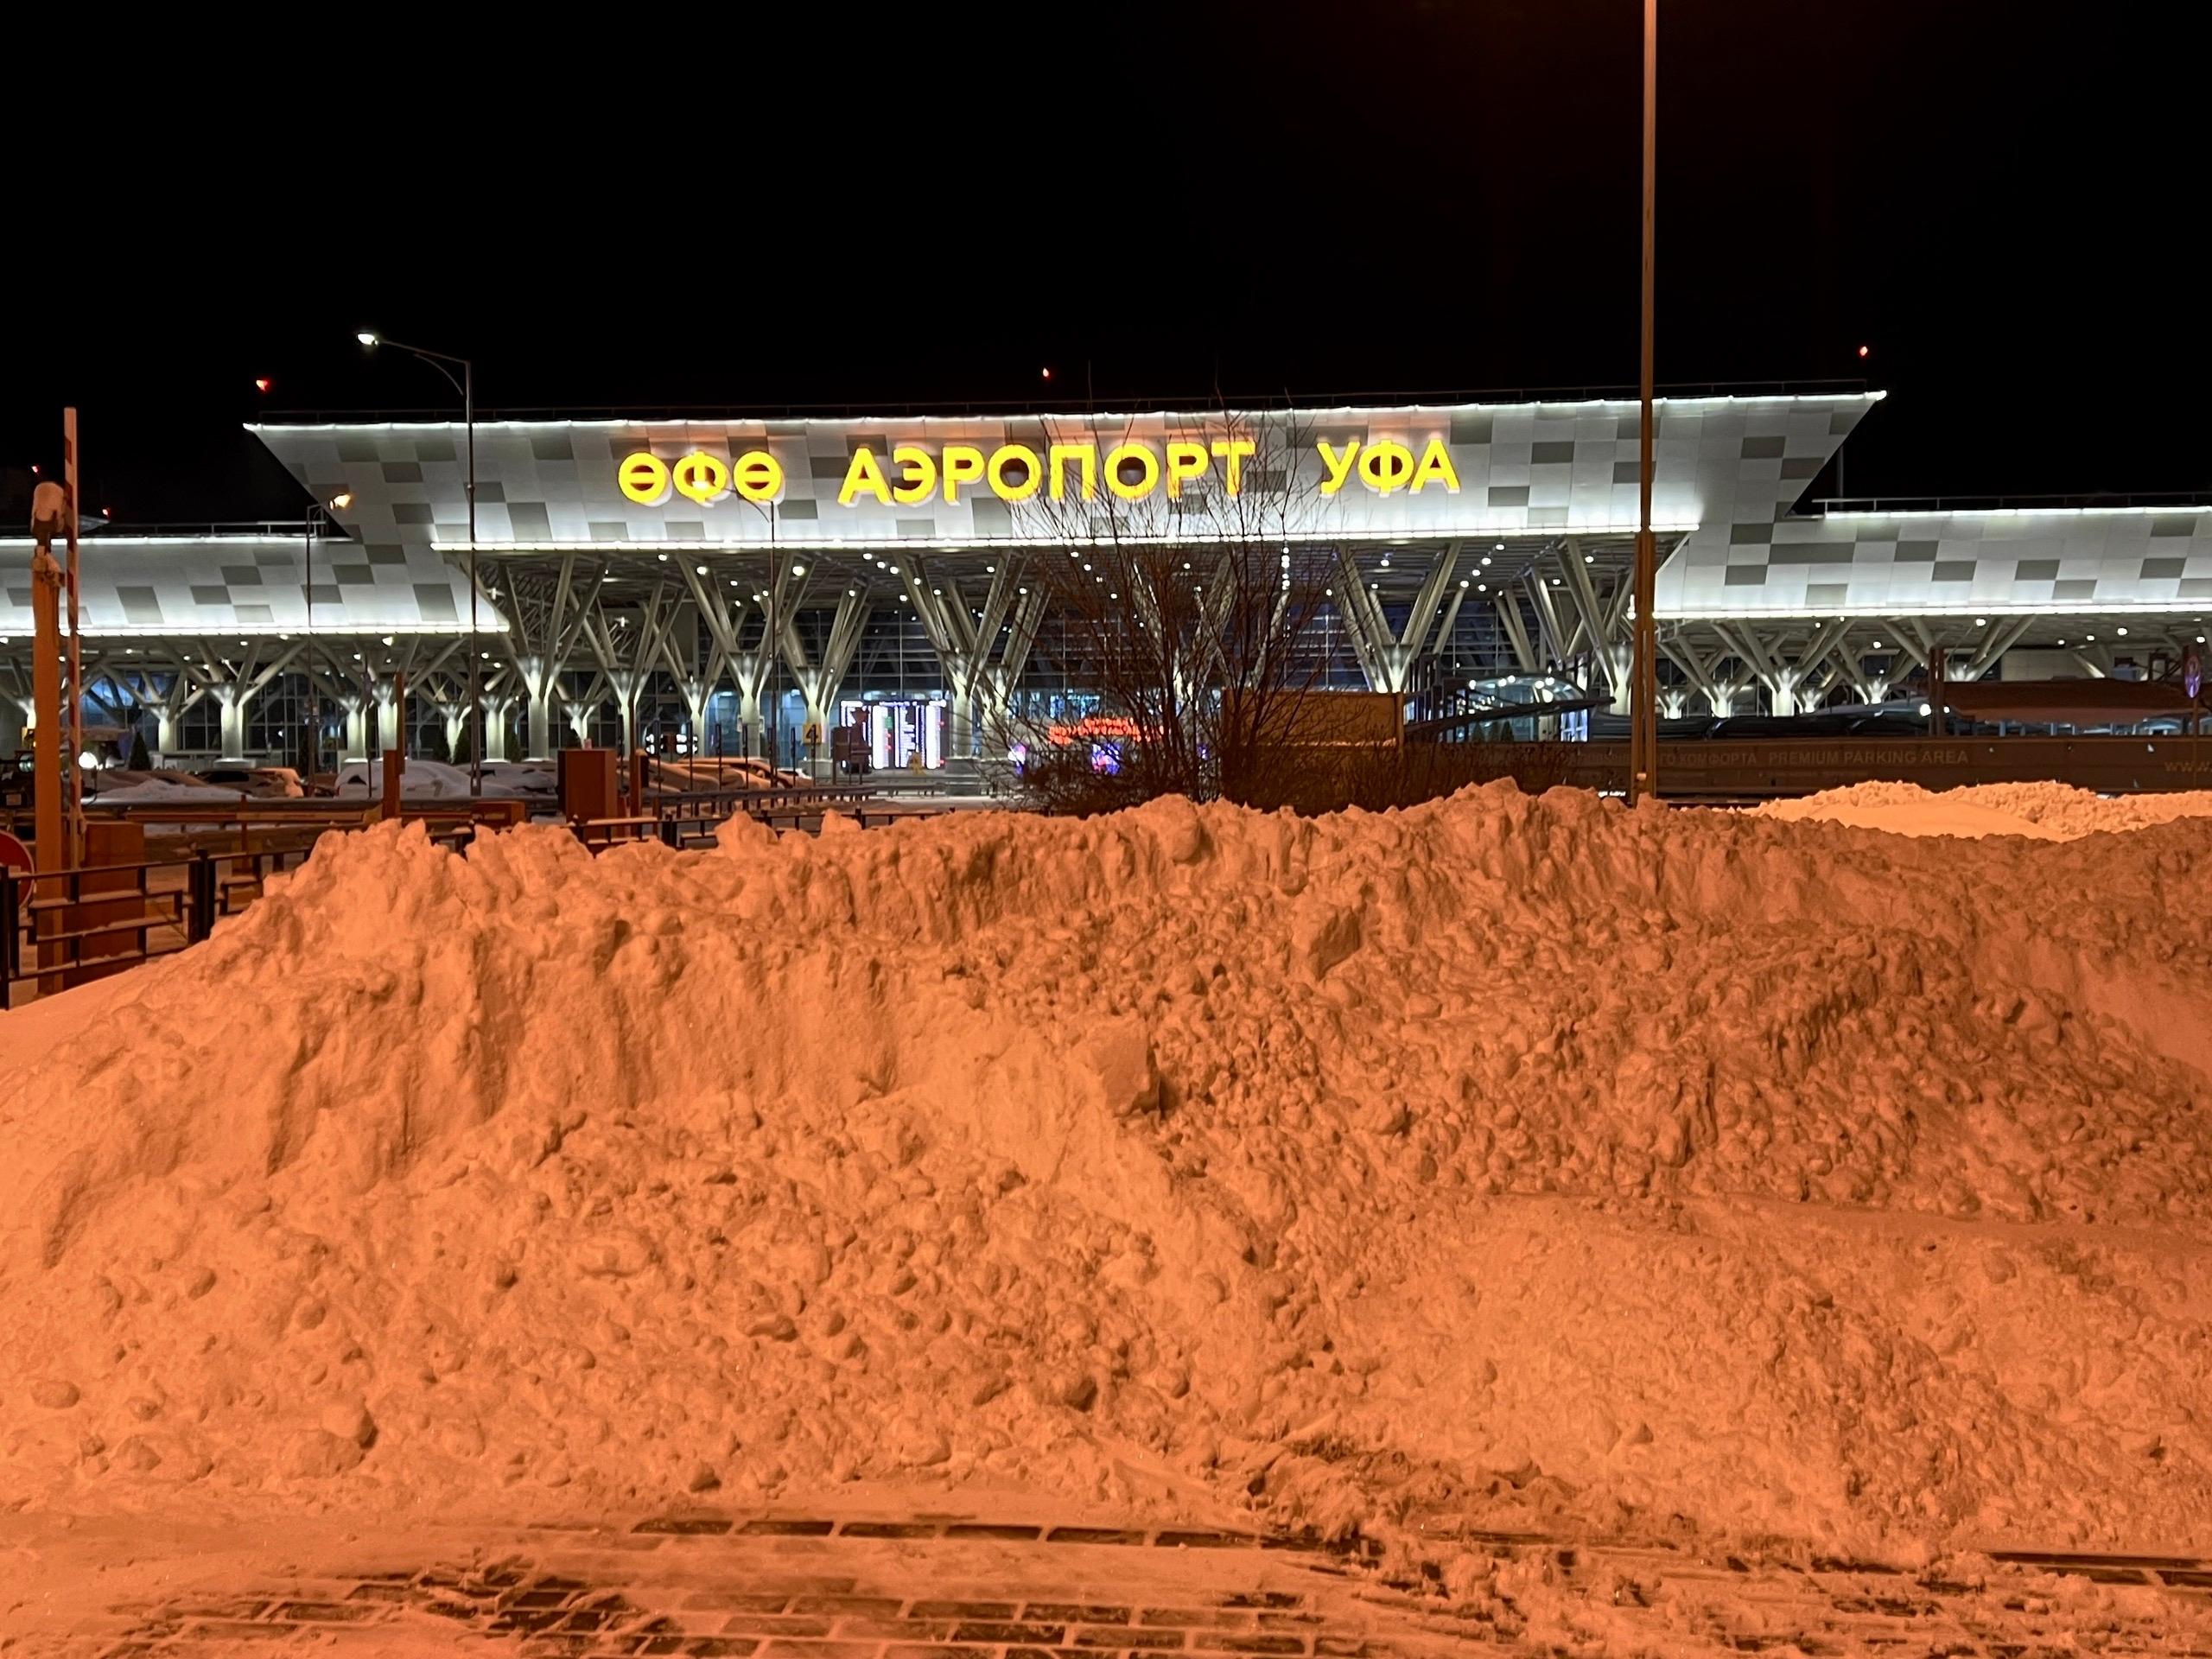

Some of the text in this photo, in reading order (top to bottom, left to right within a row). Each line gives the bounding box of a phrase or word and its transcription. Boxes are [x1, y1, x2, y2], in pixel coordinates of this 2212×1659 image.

[618, 440, 1459, 504] ӨФӨ АЭРОПОРТ УФА
[805, 723, 819, 743] 4
[1769, 750, 1839, 766] PREMIUM
[1844, 750, 1916, 765] PARKING
[1921, 750, 1967, 765] AREA
